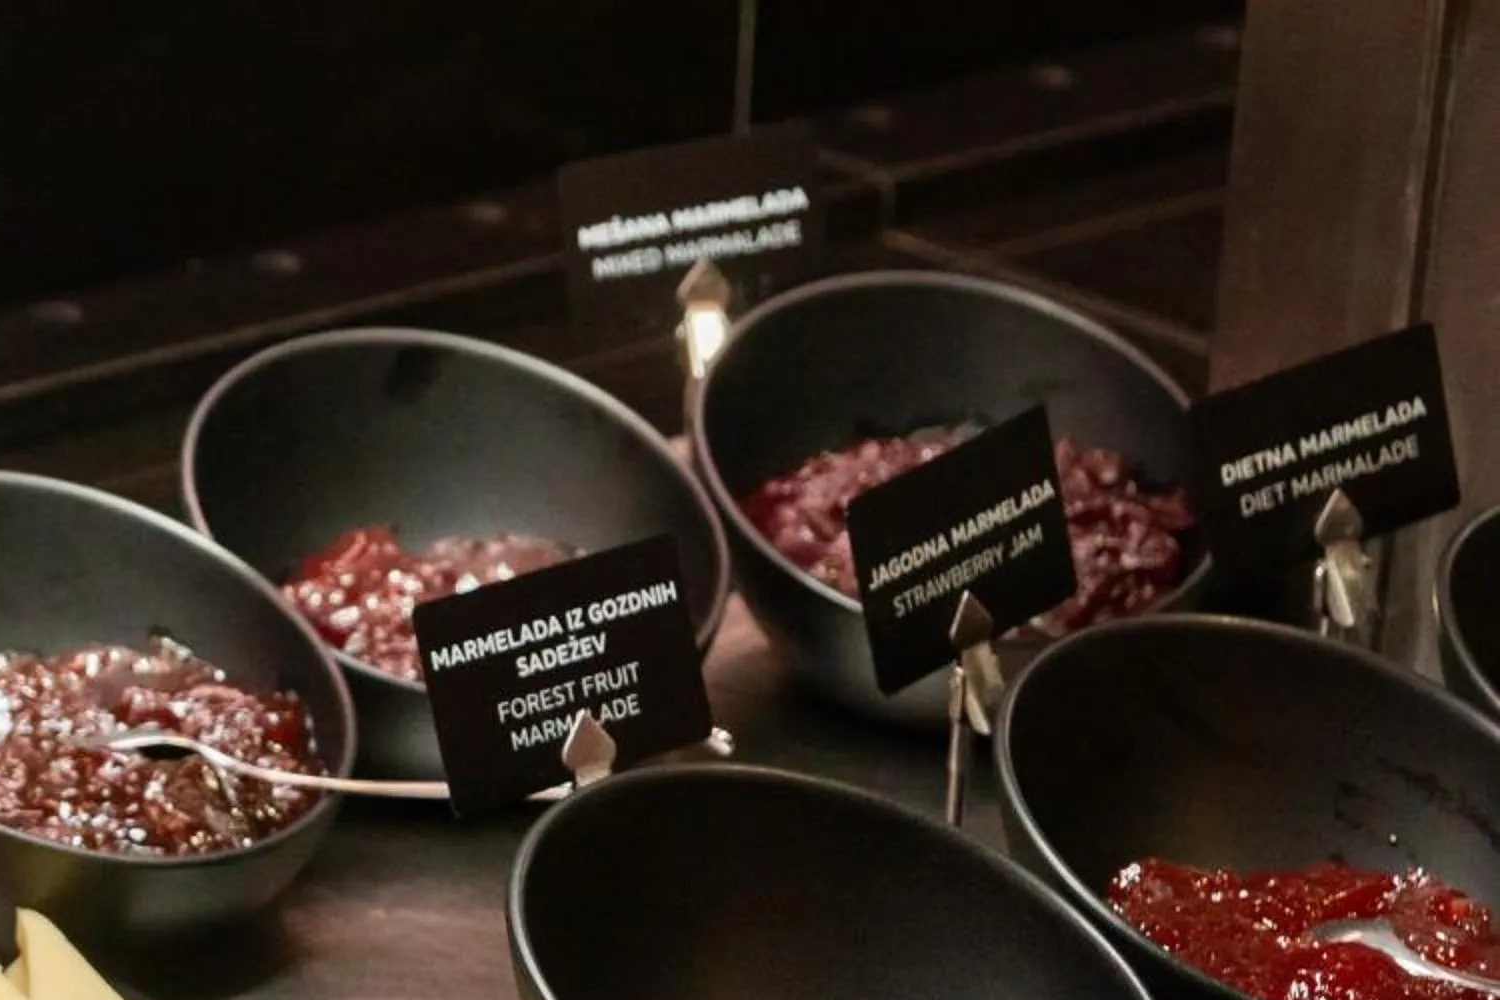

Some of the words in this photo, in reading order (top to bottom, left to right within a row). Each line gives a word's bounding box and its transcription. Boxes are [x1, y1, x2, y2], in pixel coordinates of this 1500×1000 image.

[1221, 443, 1296, 485] DIETNA
[1300, 397, 1426, 458] MARMELADA
[1240, 482, 1285, 517] DIET
[1291, 435, 1418, 496] MARMALADE
[869, 534, 950, 590] JAGODNA
[951, 480, 1054, 547] MARMELADA
[893, 544, 1003, 617] STRAWBERRY
[1010, 524, 1042, 558] JAM
[431, 616, 563, 670] MARMELADA
[566, 608, 585, 631] IZ
[588, 581, 676, 624] GOZDNIH
[516, 632, 605, 677] SADEŽEV
[498, 681, 575, 722] FOREST
[582, 662, 639, 697] FRUIT
[510, 693, 641, 752] MARMADE
